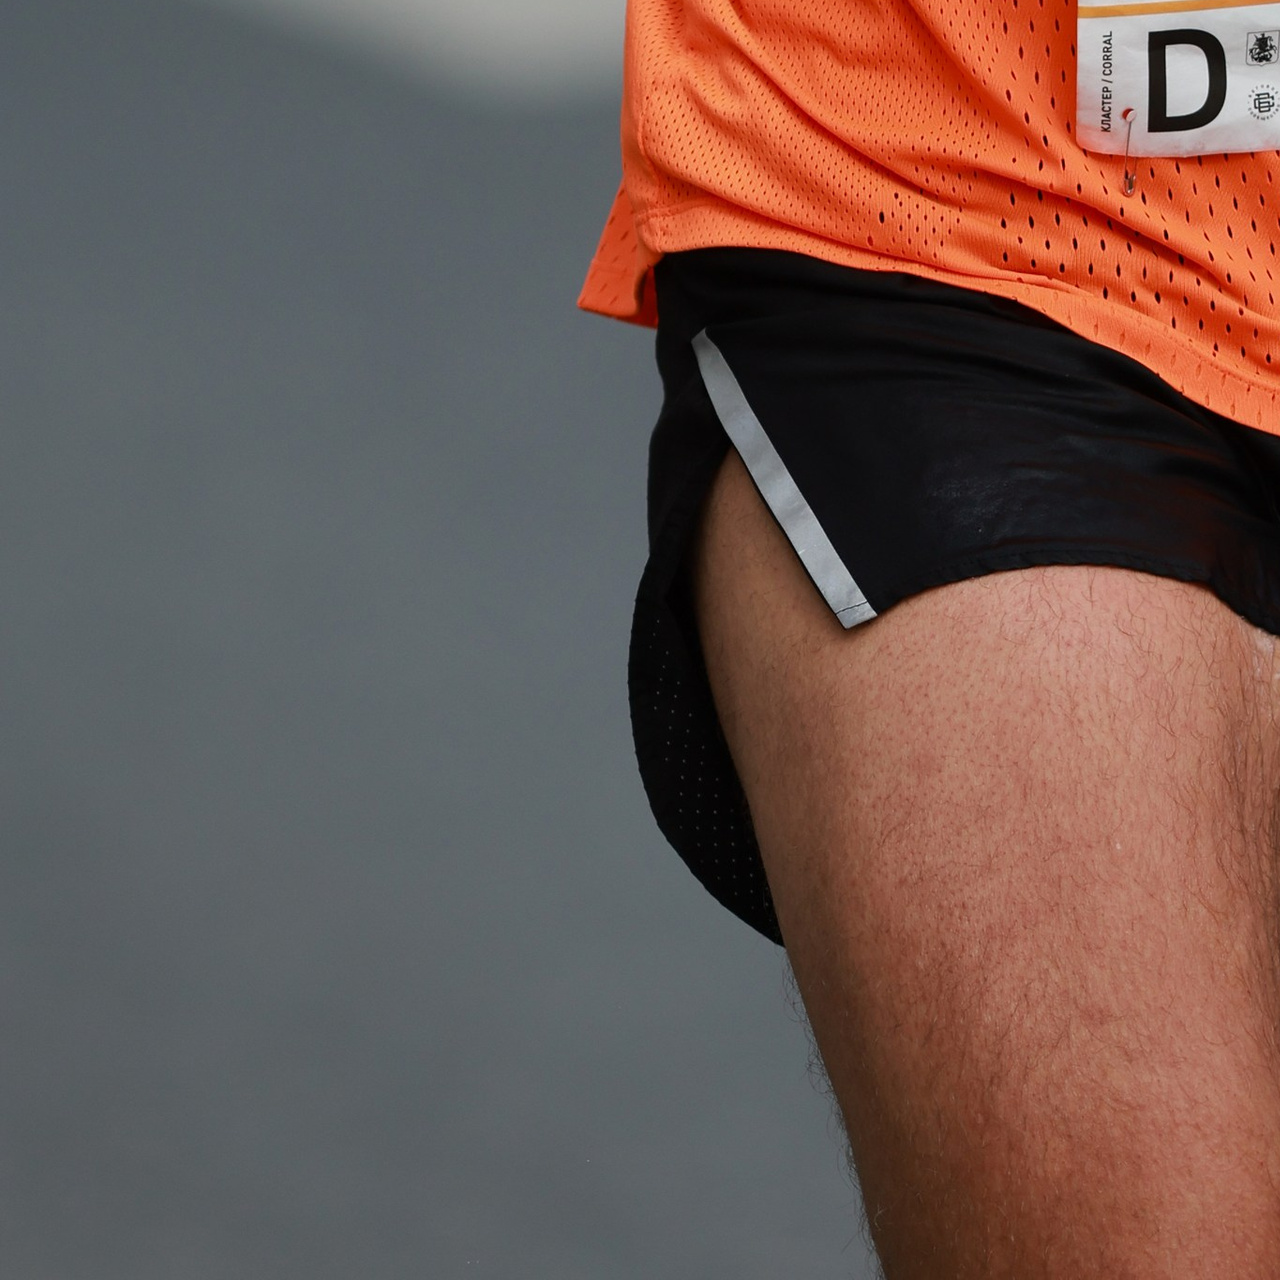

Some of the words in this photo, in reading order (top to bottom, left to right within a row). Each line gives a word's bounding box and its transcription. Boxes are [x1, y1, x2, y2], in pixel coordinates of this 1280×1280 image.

[1103, 31, 1112, 76] CORRAL
[1147, 28, 1227, 133] D
[1101, 86, 1112, 132] КЛАСТЕР
